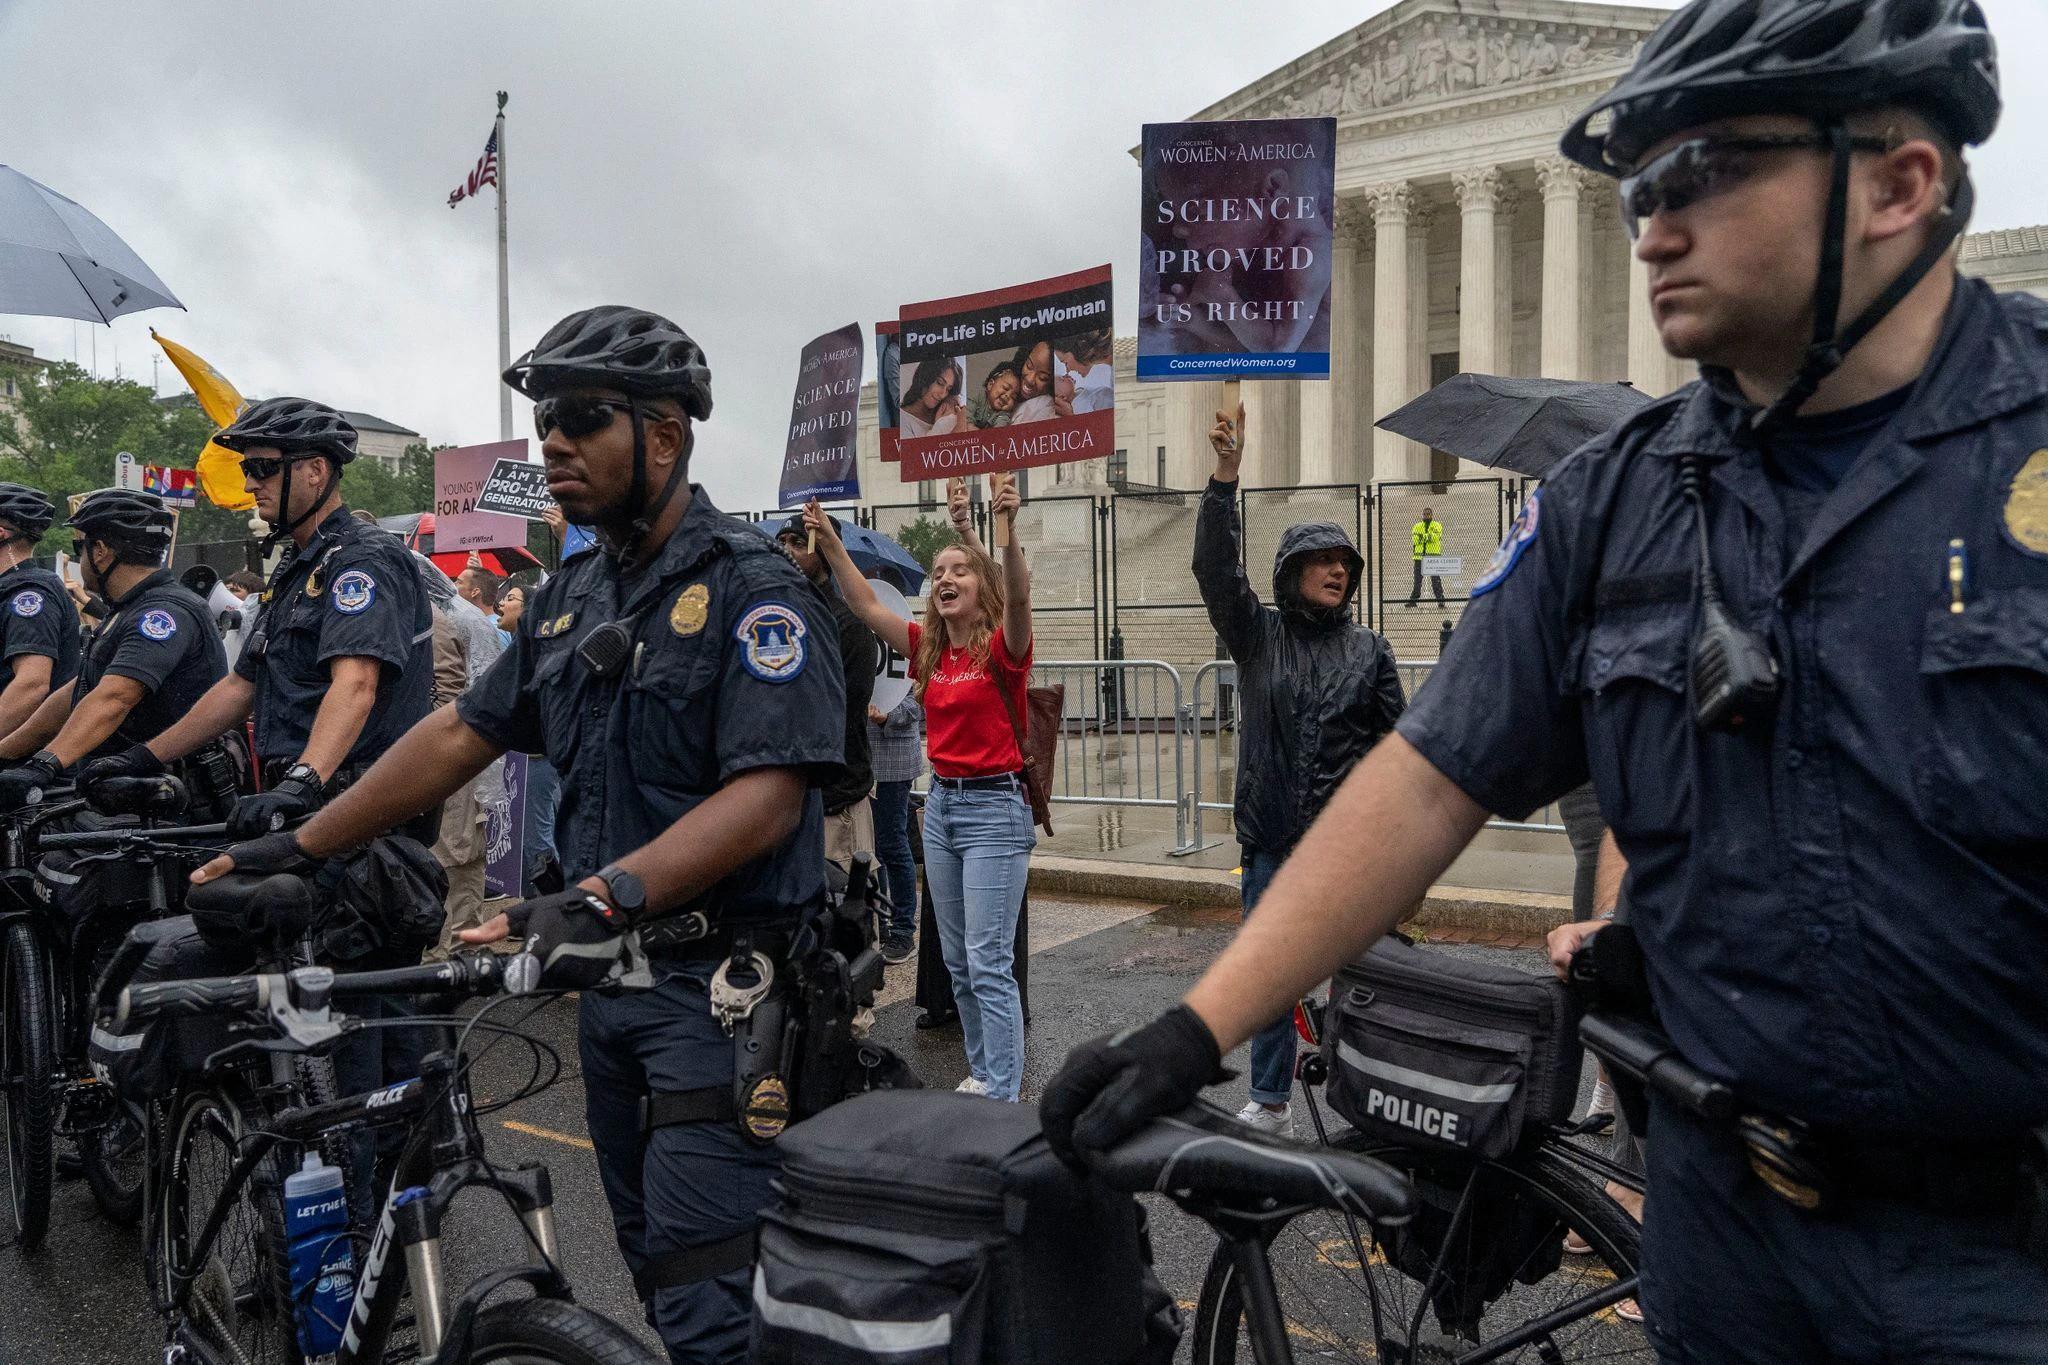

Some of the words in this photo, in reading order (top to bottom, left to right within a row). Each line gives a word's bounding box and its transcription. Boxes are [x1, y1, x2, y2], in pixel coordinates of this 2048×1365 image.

[1176, 139, 1213, 147] CONCERNED
[1379, 132, 1442, 157] JUSTICE
[1451, 121, 1507, 143] UNDER
[1512, 114, 1548, 132] LAW
[1161, 146, 1227, 164] WOMEN
[1236, 143, 1316, 162] AMERICA
[1157, 196, 1316, 224] SCIENCE
[1156, 246, 1314, 274] PROVED
[906, 324, 977, 348] Pro-Life
[981, 320, 995, 337] is
[1000, 298, 1107, 333] Pro-Woman
[1156, 303, 1192, 323] US
[1206, 301, 1315, 322] RIGHT.
[822, 346, 858, 365] AMERICA
[1169, 357, 1297, 369] ConcernedWomen.org
[795, 377, 856, 410] SCIENCE
[791, 410, 852, 440] PROVED
[920, 443, 996, 470] WOMEN
[1006, 429, 1095, 461] AMERICA
[939, 438, 980, 448] CONCERNED
[786, 456, 800, 471] US
[803, 445, 851, 466] RIGHT.
[496, 469, 503, 477] I
[506, 470, 531, 481] AM
[443, 483, 477, 496] YOUNG
[437, 499, 459, 516] FOR
[484, 493, 556, 510] GENERATION
[365, 1084, 409, 1110] POLICE
[1367, 1088, 1459, 1141] POLICE
[297, 1204, 319, 1218] LET
[320, 1199, 340, 1213] THE
